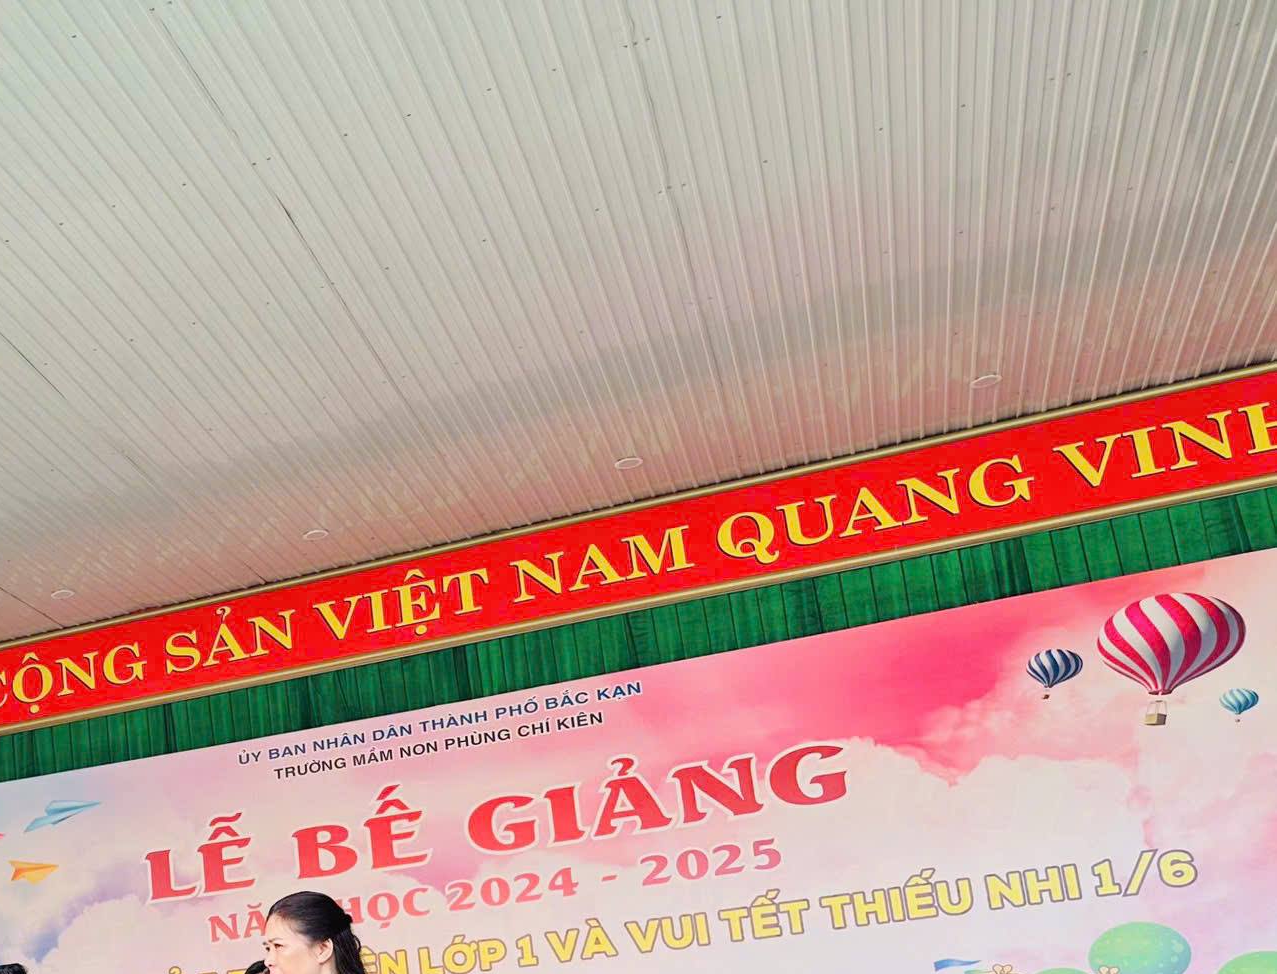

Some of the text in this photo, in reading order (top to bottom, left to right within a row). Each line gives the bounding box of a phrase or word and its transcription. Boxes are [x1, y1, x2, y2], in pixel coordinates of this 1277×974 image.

[164, 607, 296, 675] SẢN
[313, 568, 489, 636] VIỆT
[509, 524, 694, 602] NAM
[716, 454, 1034, 565] QUANG
[238, 682, 641, 765] ỦY BAN NHÂN DÂN THÀNH PHỐ BẮC KẠN
[274, 711, 603, 780] TRƯỜNG MẦM NON PHÙNG CHÍ KIÊN
[145, 745, 848, 900] LỄ BẾ GIẢNG
[208, 902, 267, 942] NĂ
[446, 867, 580, 911] 2024
[640, 838, 783, 886] 2025
[515, 934, 540, 967] 1
[545, 918, 619, 963] VÀ
[624, 912, 712, 953] VUI
[718, 888, 810, 942] TẾT
[819, 868, 973, 930] THIẾU
[984, 864, 1083, 910] NHI
[1091, 849, 1199, 898] 1/6
